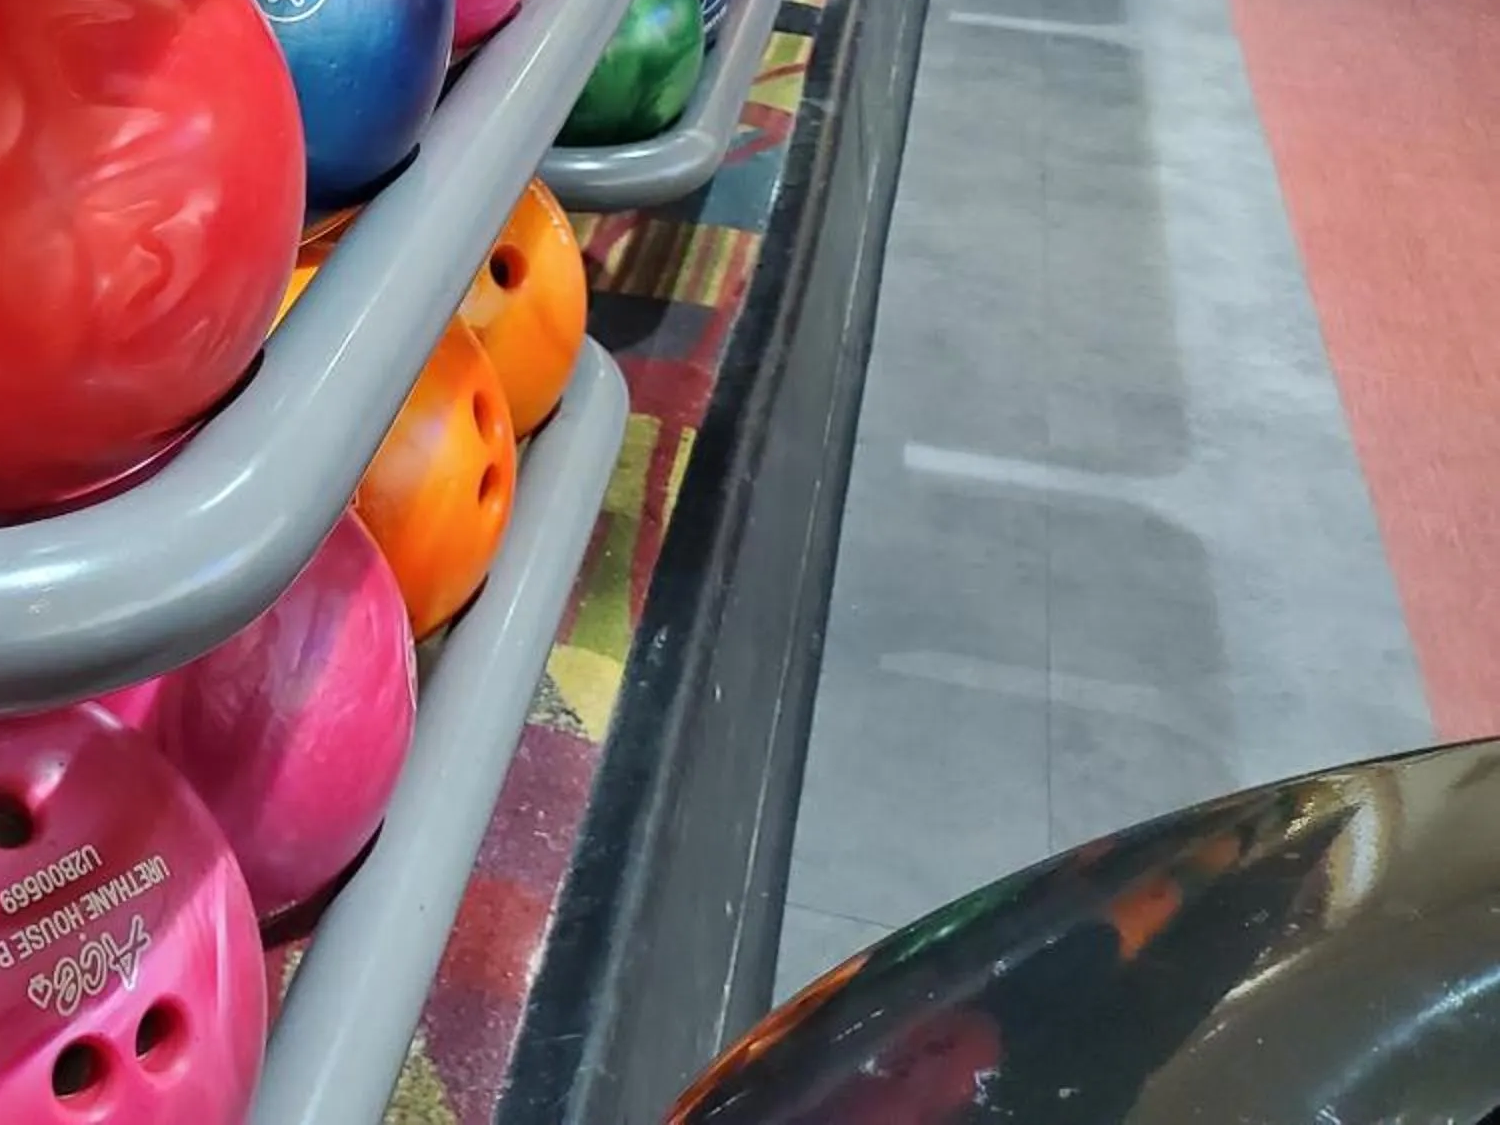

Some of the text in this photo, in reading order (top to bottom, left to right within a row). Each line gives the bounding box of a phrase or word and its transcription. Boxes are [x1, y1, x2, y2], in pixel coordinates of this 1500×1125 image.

[85, 856, 170, 920] URETHANE
[19, 901, 86, 959] HOUSE
[54, 915, 150, 1017] Ace
